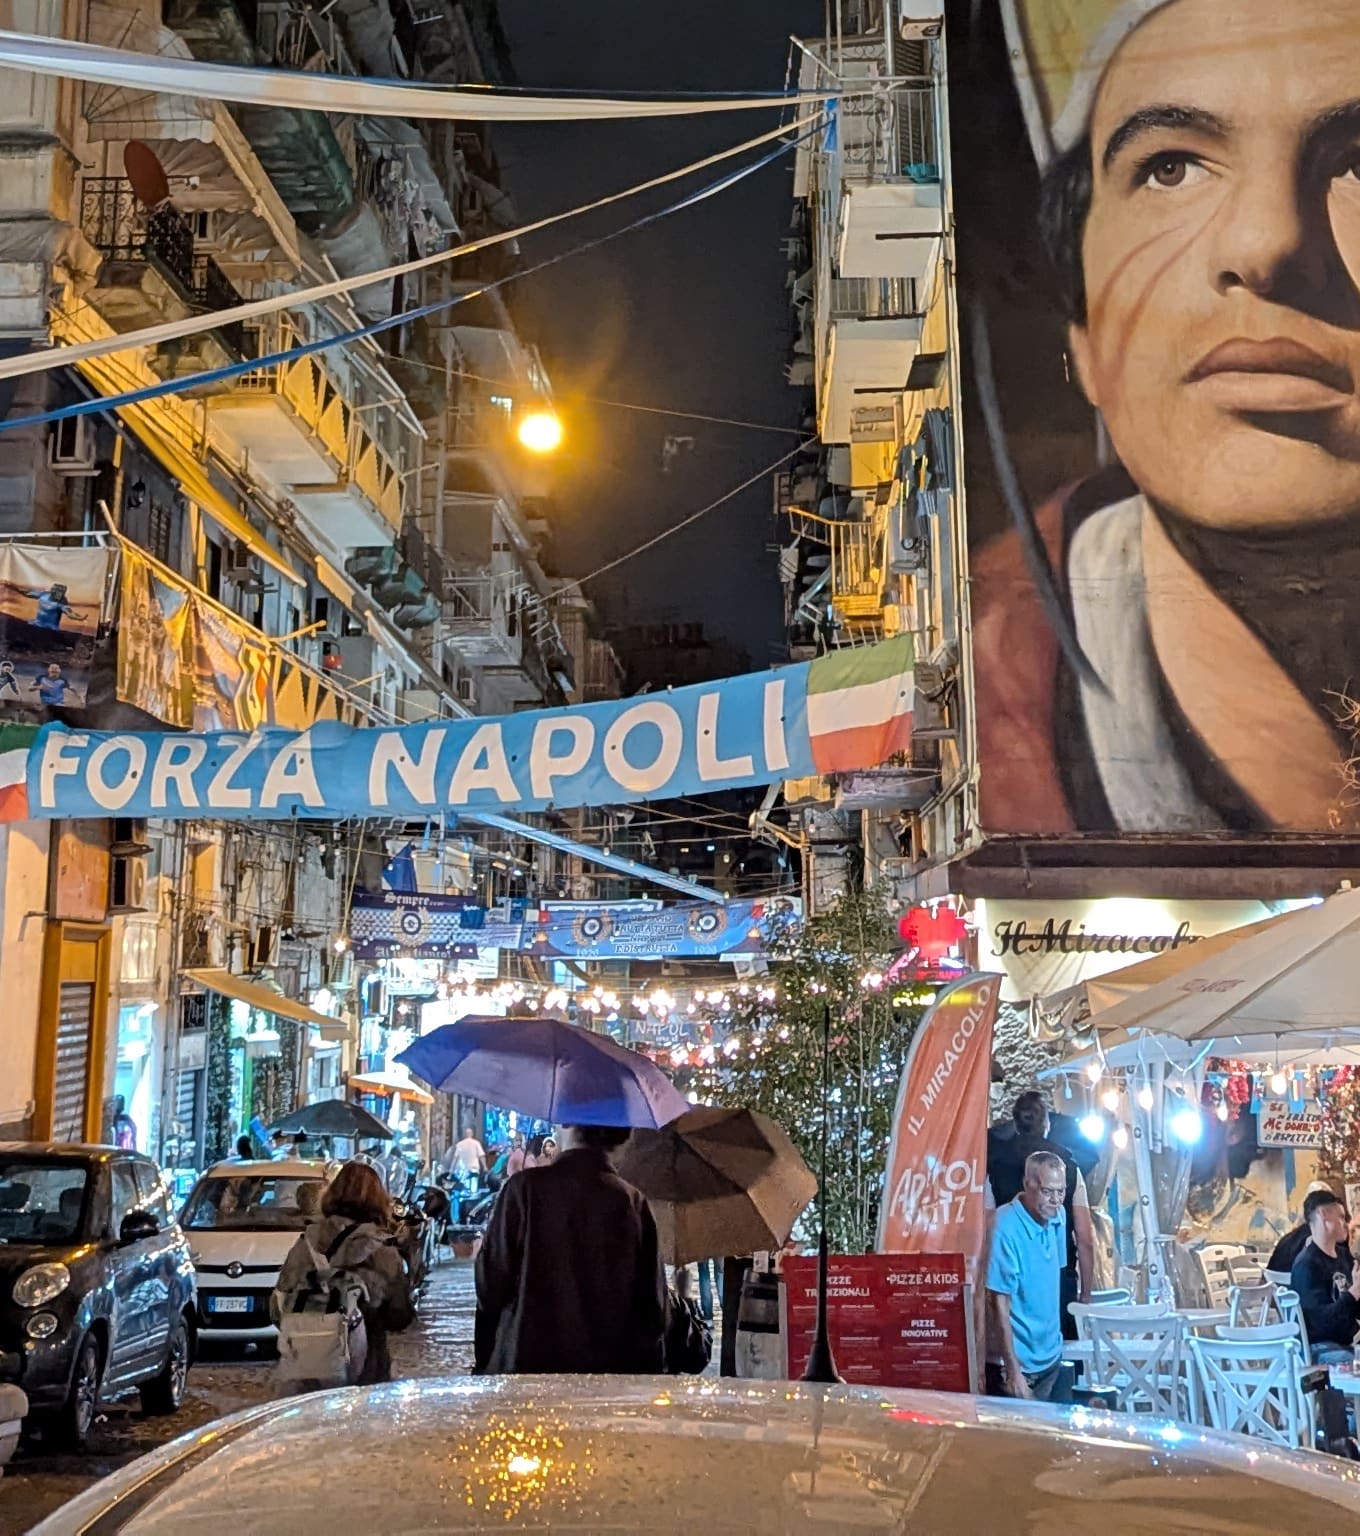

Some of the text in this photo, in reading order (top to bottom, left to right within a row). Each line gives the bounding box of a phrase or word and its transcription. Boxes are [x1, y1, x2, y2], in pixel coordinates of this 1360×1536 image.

[40, 678, 790, 811] FORZA NAPOLI
[907, 1114, 926, 1136] IL
[919, 984, 991, 1112] MIRACOLO
[889, 1274, 923, 1285] PIZZE
[932, 1273, 960, 1284] KIDS
[910, 1319, 936, 1328] PIZZE
[900, 1329, 948, 1338] INNOVATIVE
